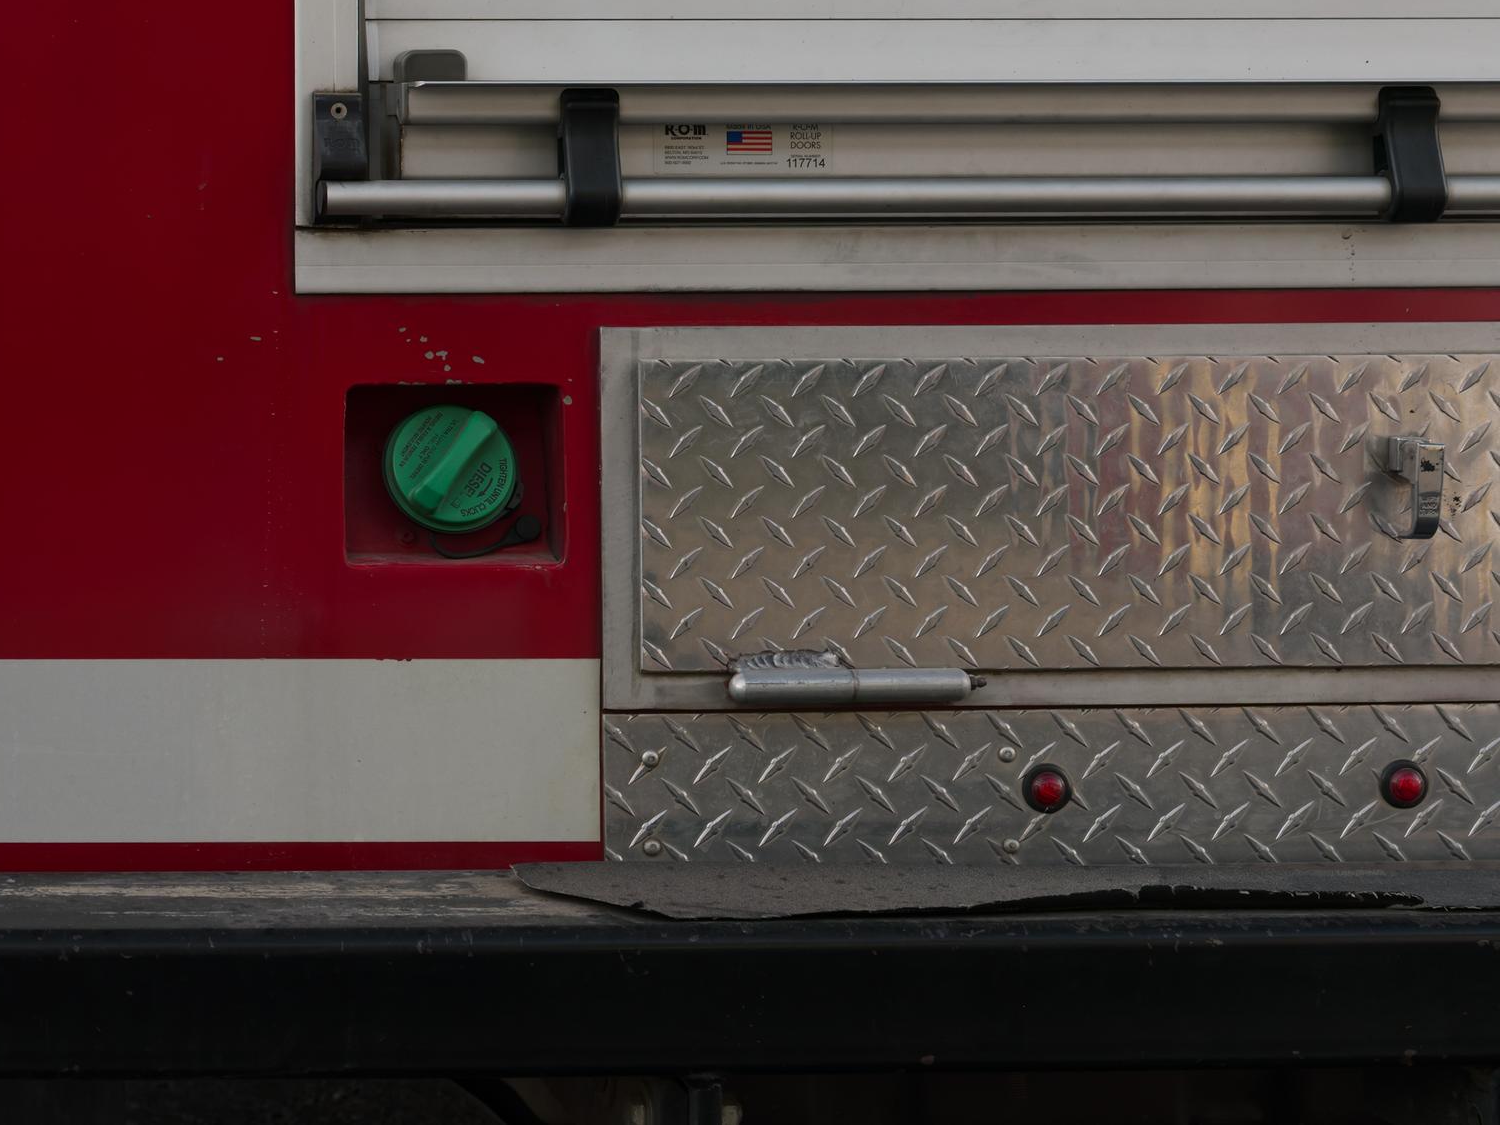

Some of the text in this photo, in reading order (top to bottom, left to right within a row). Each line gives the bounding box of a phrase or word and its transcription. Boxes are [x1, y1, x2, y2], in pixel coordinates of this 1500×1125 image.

[790, 131, 822, 140] ROLL-UP
[790, 140, 821, 149] DOORS
[786, 158, 825, 168] 117714
[459, 458, 507, 517] TIGHTEN UNTIL CLICKS
